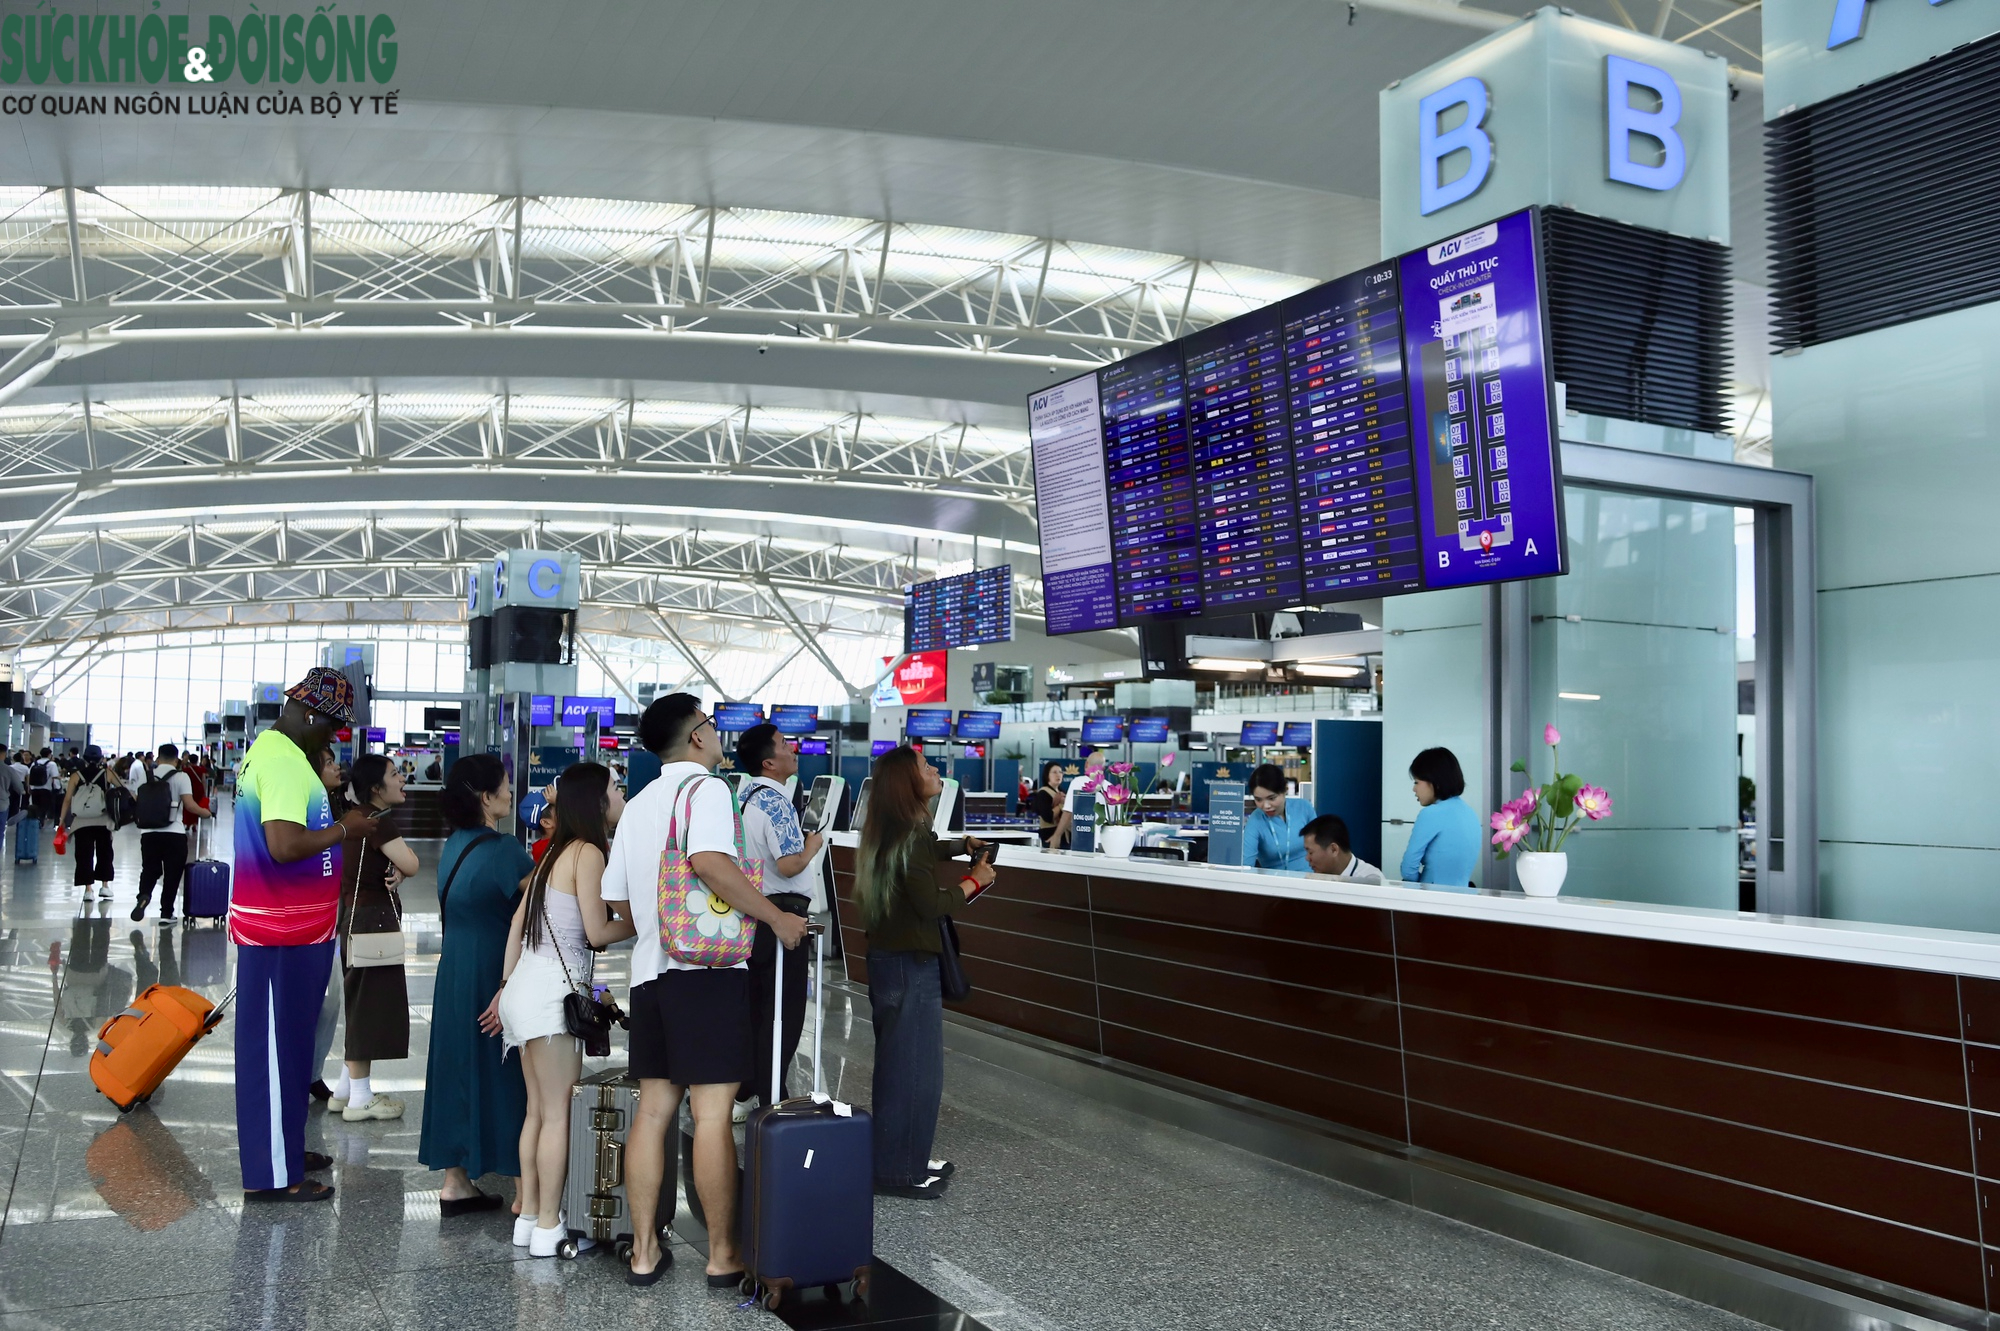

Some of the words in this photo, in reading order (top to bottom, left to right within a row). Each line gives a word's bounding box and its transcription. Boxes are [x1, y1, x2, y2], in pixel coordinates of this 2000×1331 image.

[1603, 54, 1686, 192] B
[1420, 76, 1493, 216] B
[1439, 240, 1463, 259] ACV
[1372, 270, 1393, 285] 10:33
[1430, 270, 1456, 290] QUẦY
[1457, 263, 1478, 279] THỦ
[1479, 256, 1499, 271] TỤC
[1438, 281, 1464, 296] CHECK-IN
[1464, 272, 1492, 287] COUNTER
[1491, 382, 1500, 391] 09
[1448, 393, 1457, 402] 09
[1492, 393, 1501, 402] 08
[1033, 396, 1049, 411] ACV
[1449, 404, 1458, 412] 08
[1494, 415, 1503, 424] 07
[1451, 425, 1460, 434] 07
[1494, 425, 1504, 435] 06
[1451, 435, 1461, 445] 06
[1496, 448, 1506, 457] 05
[1453, 457, 1463, 466] 05
[1497, 459, 1507, 468] 04
[1454, 468, 1464, 477] 04
[1499, 481, 1508, 490] 03
[1456, 489, 1465, 498] 03
[1500, 492, 1509, 501] 02
[1457, 500, 1466, 509] 02
[1502, 514, 1511, 523] 01
[1459, 521, 1467, 531] 01
[1524, 538, 1538, 556] A
[1438, 551, 1450, 568] B
[495, 560, 505, 599] C
[528, 559, 562, 598] C
[468, 575, 478, 610] D
[263, 685, 279, 701] G
[564, 705, 589, 715] ACV
[733, 812, 744, 844] WIGGLE
